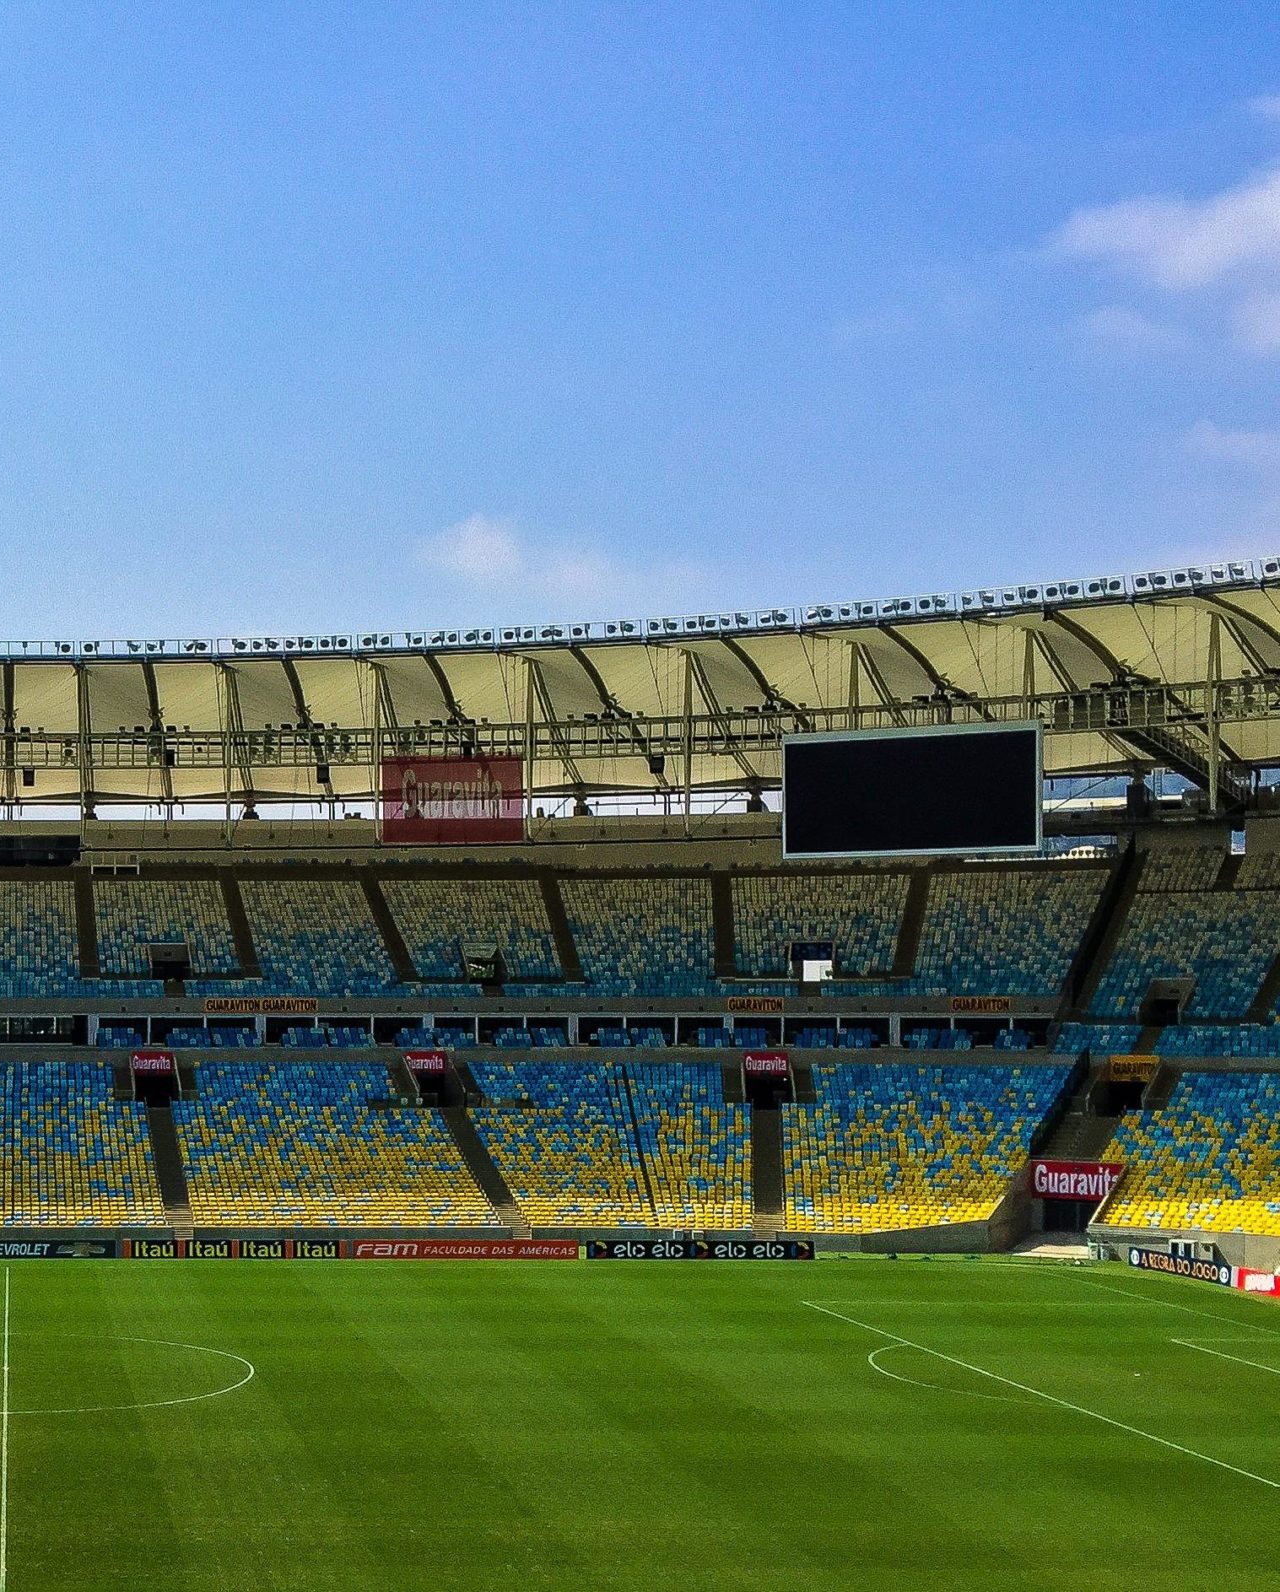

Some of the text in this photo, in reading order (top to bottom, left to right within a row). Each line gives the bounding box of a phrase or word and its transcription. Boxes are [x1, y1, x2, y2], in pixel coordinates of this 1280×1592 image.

[402, 768, 503, 819] Guaravita
[132, 1055, 171, 1070] Guaravita
[745, 1056, 787, 1071] Guaravita
[134, 1241, 336, 1258] Itaú Itaú Itaú Itaú
[423, 1245, 487, 1255] FACULDADE
[491, 1245, 514, 1255] DAS
[518, 1244, 576, 1256] AMÉRICAS
[1141, 1252, 1148, 1267] A
[1176, 1258, 1191, 1275] DO
[1191, 1261, 1218, 1280] JOGO
